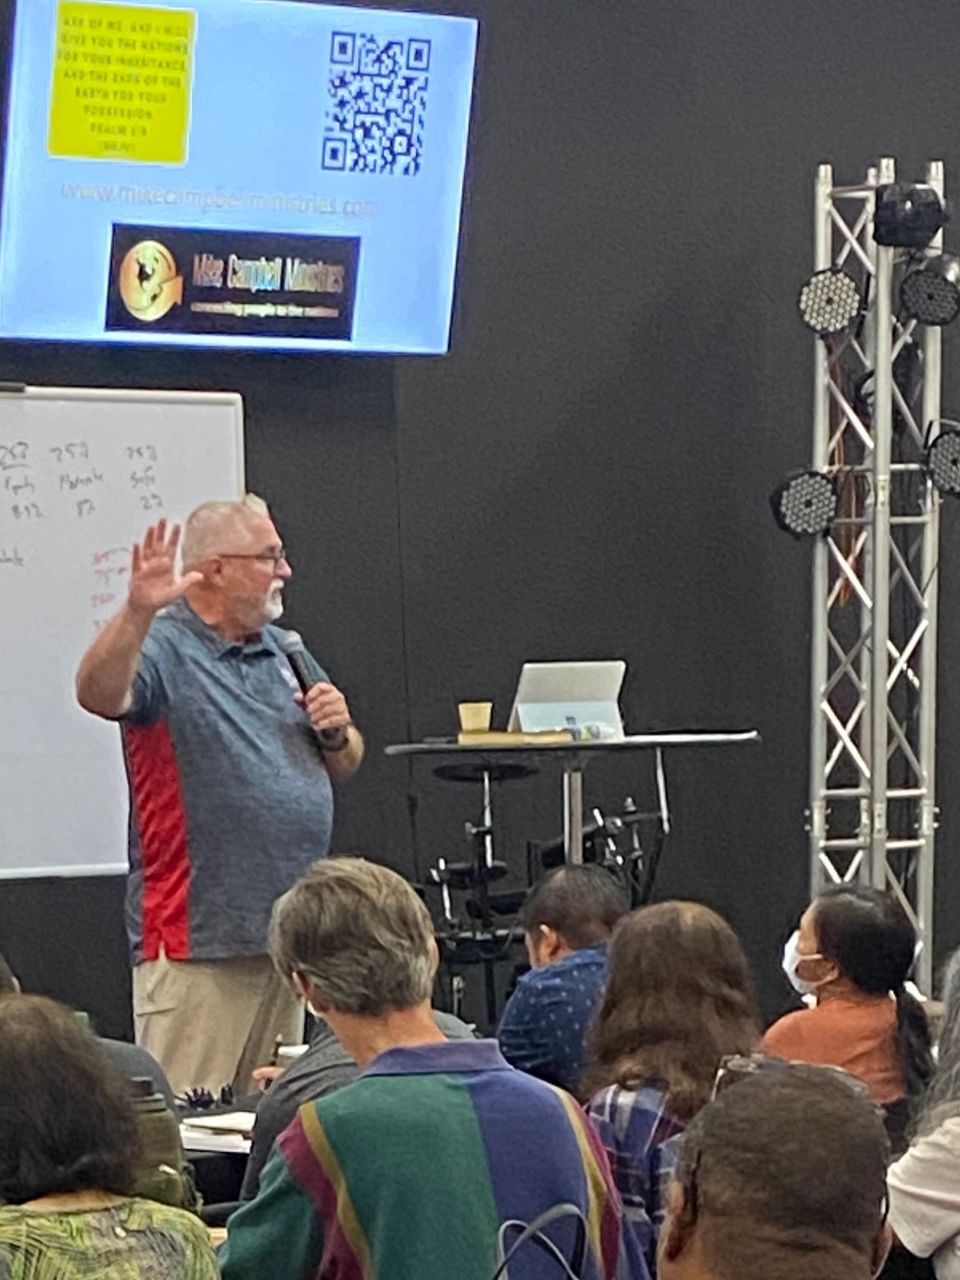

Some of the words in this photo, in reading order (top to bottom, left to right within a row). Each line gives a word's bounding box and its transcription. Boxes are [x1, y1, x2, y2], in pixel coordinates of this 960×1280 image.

[117, 38, 136, 50] THE
[192, 254, 224, 287] Mike
[227, 254, 282, 293] Campbell
[284, 257, 344, 293] Ministries
